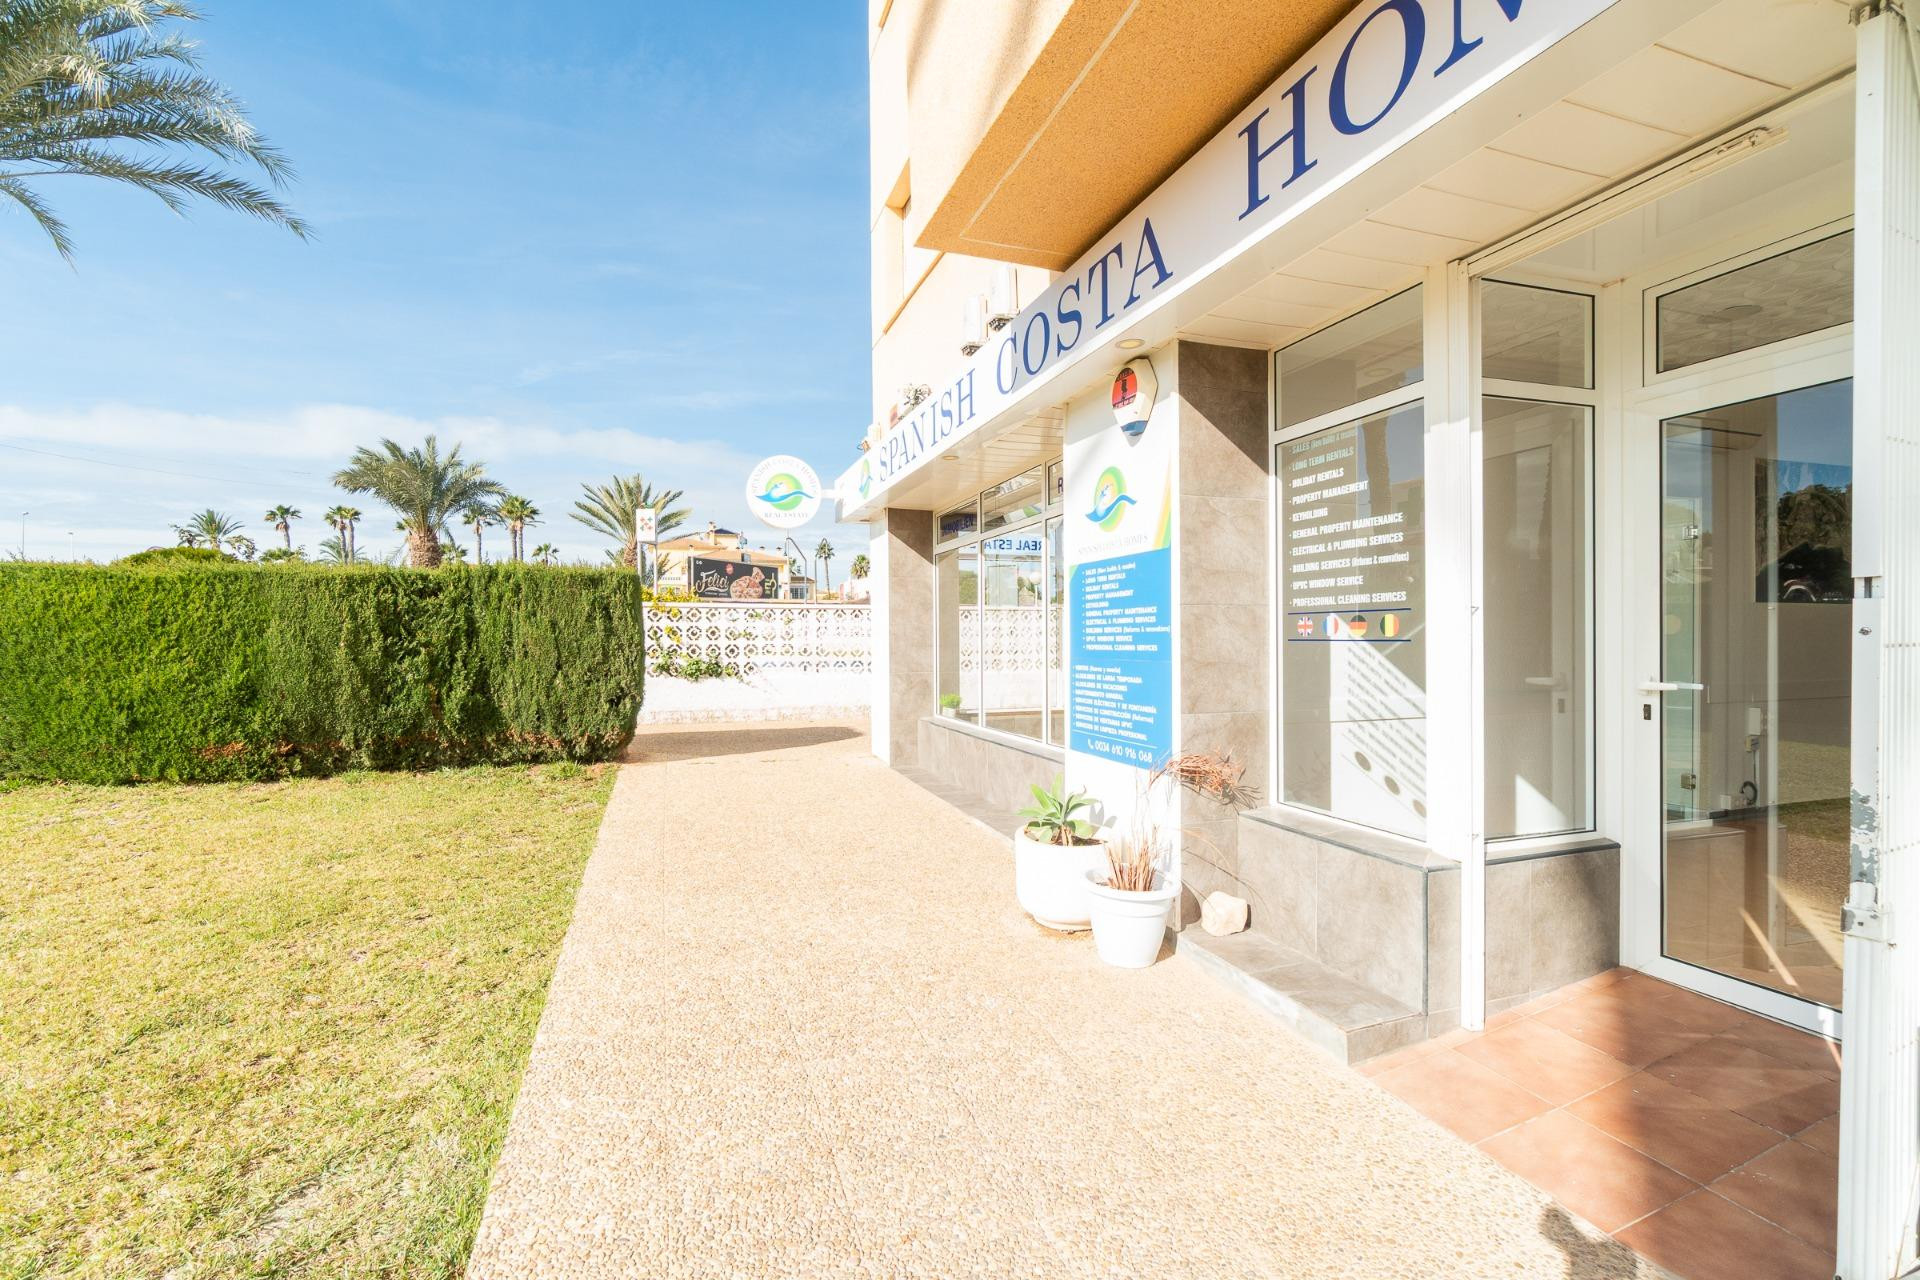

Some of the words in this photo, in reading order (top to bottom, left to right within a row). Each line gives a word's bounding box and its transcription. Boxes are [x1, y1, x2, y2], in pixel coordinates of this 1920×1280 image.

[880, 367, 977, 482] SPANISH
[996, 217, 1174, 395] COSTA
[1292, 460, 1308, 471] LONG
[1308, 455, 1325, 466] TERM
[1326, 447, 1354, 462] RENTALS
[1292, 475, 1316, 488] HOLIDAY
[1318, 468, 1344, 482] RENTALS
[1292, 491, 1322, 506] PROPERTY
[1322, 480, 1368, 498] MANAGEMENT
[1292, 527, 1318, 539] GENERAL
[1320, 521, 1351, 534] PROPERTY
[1352, 512, 1403, 529] MAINTENANCE
[1292, 544, 1326, 556] ELECTRICAL
[1327, 542, 1332, 551] &
[1334, 538, 1368, 551] PLUMBING
[1369, 532, 1404, 546] SERVICES
[1292, 562, 1319, 573] BUILDING
[1320, 558, 1350, 570] SERVICES
[1309, 578, 1336, 588] WINDOW
[1336, 576, 1364, 586] SERVICE
[1292, 596, 1336, 606] PROFESSIONAL
[1338, 594, 1370, 604] CLEANING
[1372, 591, 1406, 602] SERVICES
[1095, 740, 1110, 753] 0034
[1112, 745, 1122, 755] 610
[1125, 748, 1136, 759] 916
[1139, 751, 1152, 763] 068
